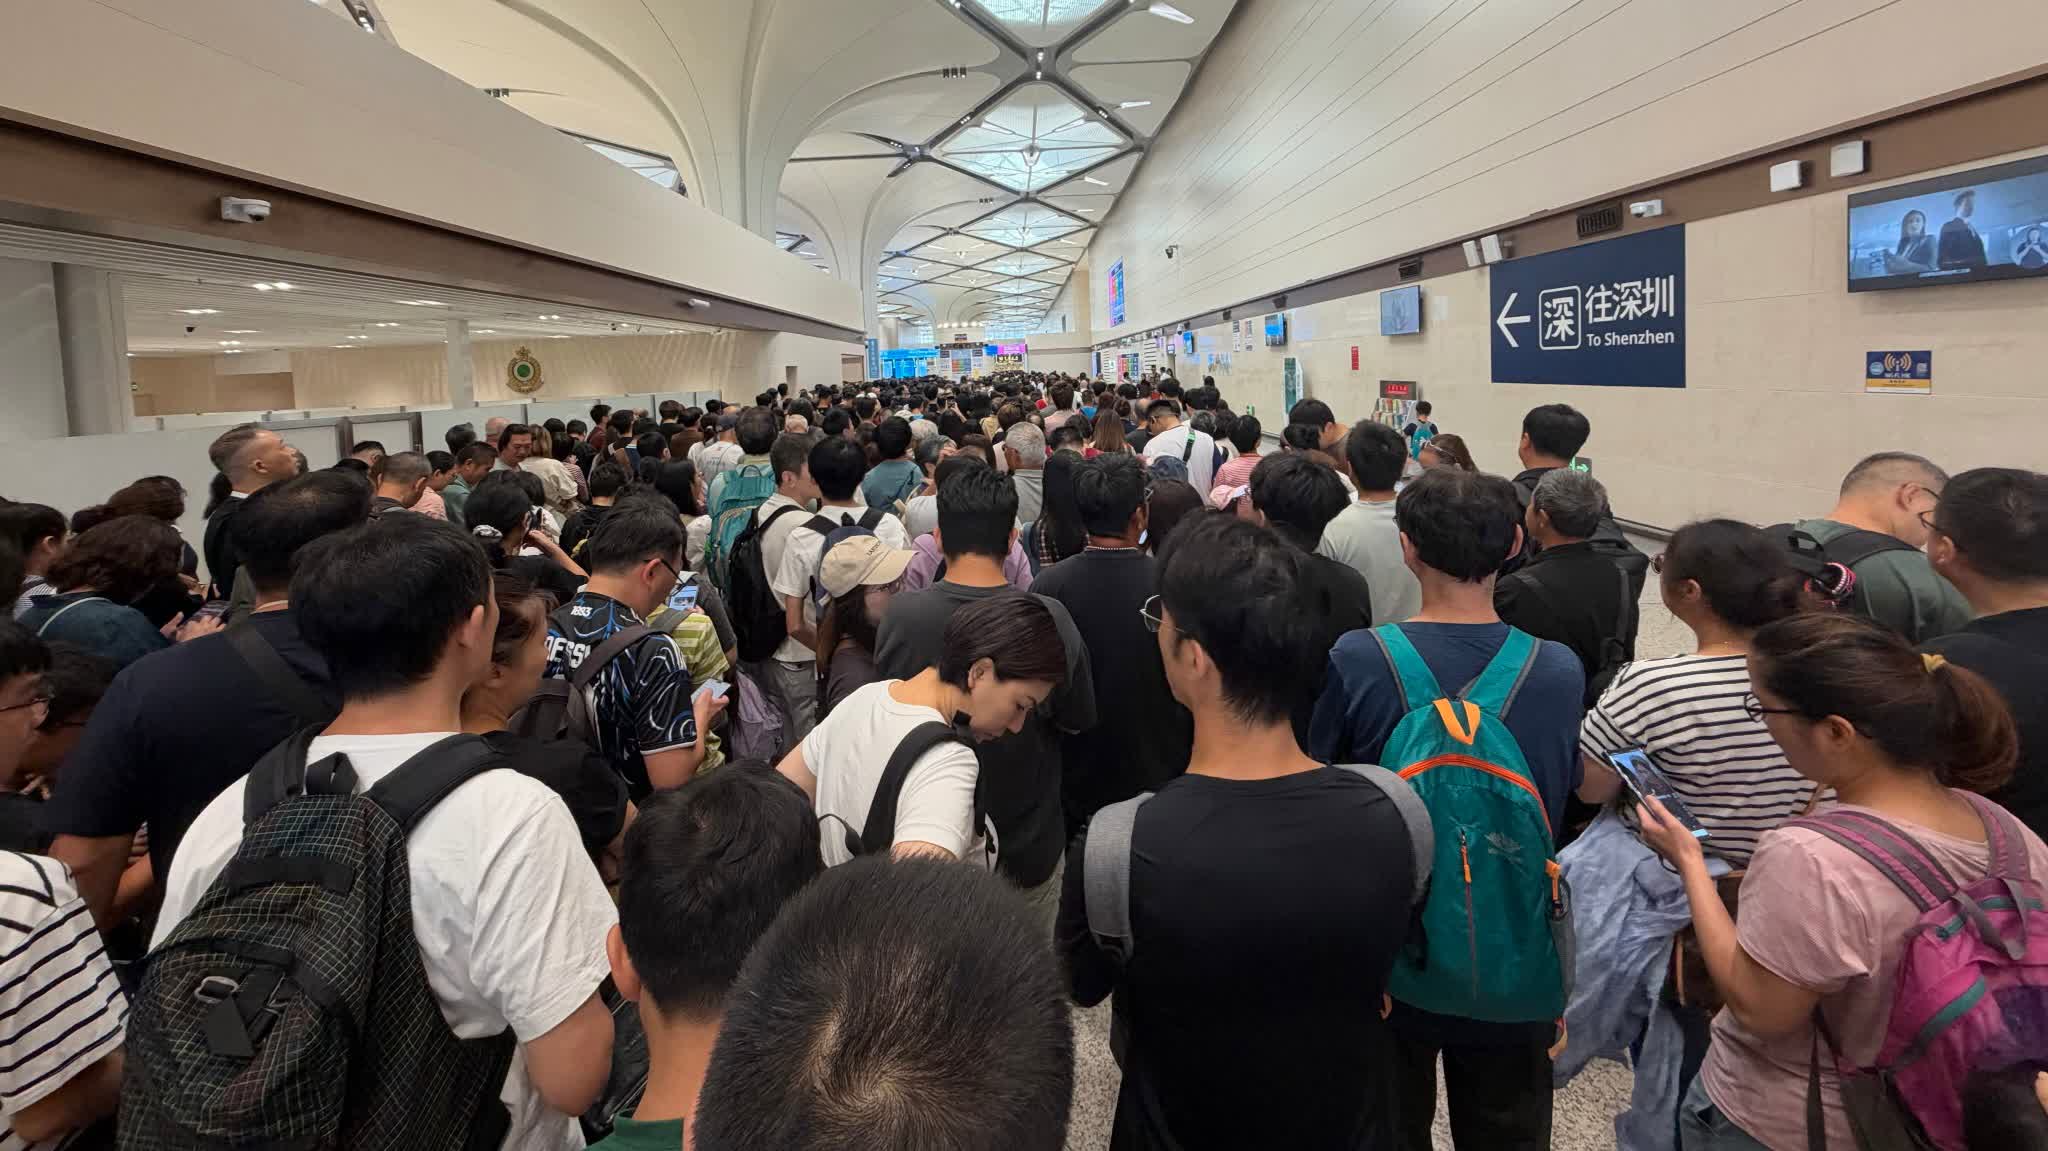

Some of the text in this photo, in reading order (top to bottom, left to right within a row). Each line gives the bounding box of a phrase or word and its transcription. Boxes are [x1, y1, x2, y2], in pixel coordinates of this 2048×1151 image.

[1543, 296, 1575, 342] 深
[1584, 275, 1675, 324] 往深圳
[1586, 330, 1675, 347] To Shenzhen
